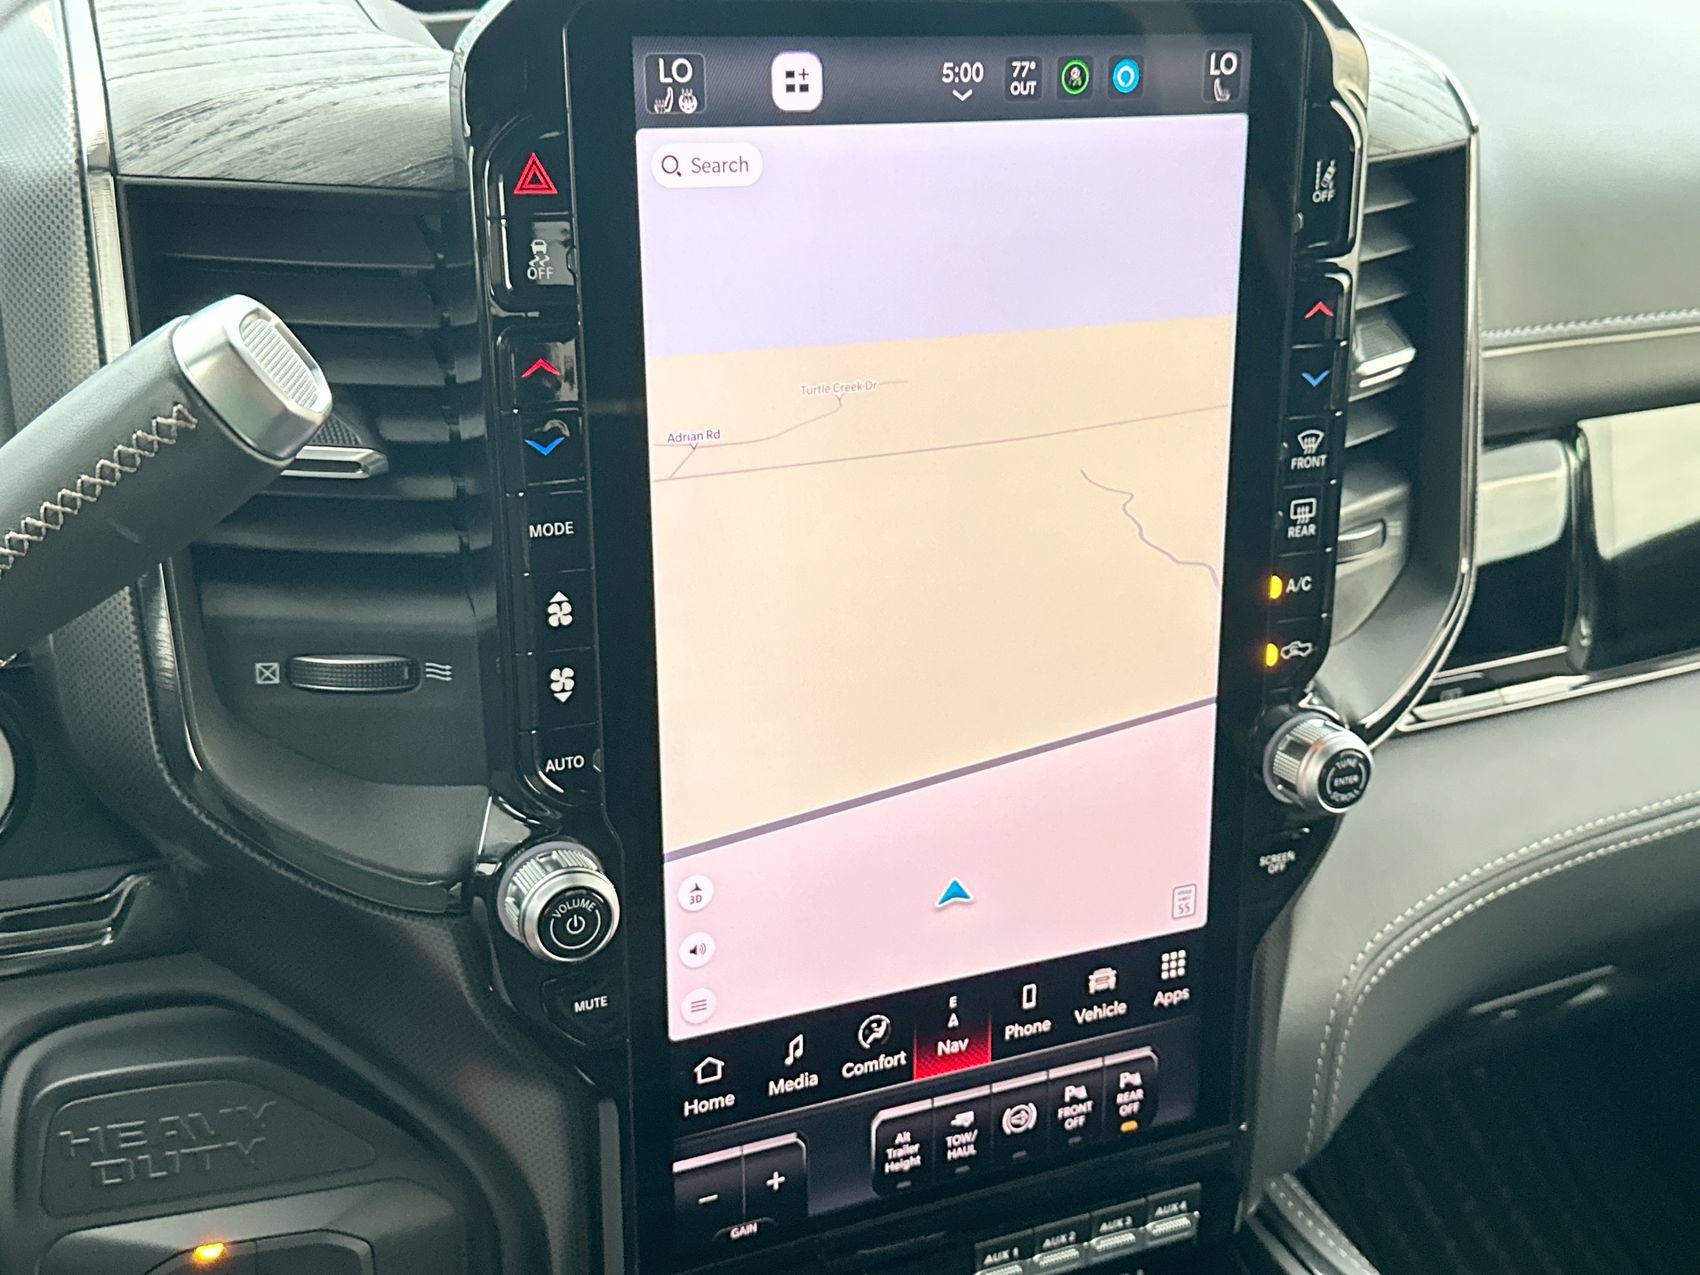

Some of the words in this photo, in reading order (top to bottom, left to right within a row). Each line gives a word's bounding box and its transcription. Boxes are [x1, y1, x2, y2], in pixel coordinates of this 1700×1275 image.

[659, 57, 693, 83] LO
[941, 61, 984, 83] 5:00
[1210, 51, 1238, 76] LO
[1010, 81, 1037, 95] OUT
[690, 155, 750, 176] Search
[1312, 189, 1336, 203] OFF
[527, 267, 553, 280] OFF
[801, 384, 830, 396] Turtle
[832, 381, 863, 394] Creek
[864, 380, 878, 391] Dr
[667, 432, 704, 444] Adrian
[706, 430, 721, 441] Rd
[1291, 455, 1328, 470] FRONT
[529, 521, 575, 538] MODE
[1288, 525, 1317, 538] REAR
[1286, 576, 1313, 594] A/C
[545, 755, 585, 773] AUTO
[1336, 758, 1358, 769] TUNE
[1333, 774, 1360, 787] ENTER
[1259, 850, 1296, 867] SCREEN
[1267, 862, 1287, 875] OFF
[690, 894, 703, 904] 3D
[1178, 902, 1191, 914] 55
[552, 898, 597, 920] VOLUME
[574, 995, 609, 1014] MUTE
[1153, 986, 1191, 1008] Apps
[1073, 1000, 1127, 1025] Vehicle
[1004, 1018, 1052, 1041] Phone
[937, 1037, 969, 1056] Nav
[841, 1050, 907, 1079] Comfort
[767, 1070, 819, 1097] Media
[683, 1092, 736, 1118] Home
[1116, 1088, 1145, 1105] REAR
[1057, 1100, 1094, 1120] FRONT
[1119, 1101, 1140, 1117] OFF
[58, 1100, 278, 1157] HEAVY
[1064, 1114, 1086, 1131] OFF
[945, 1129, 979, 1147] TOW/
[89, 1135, 266, 1185] DUTY
[886, 1143, 920, 1159] Trailer
[946, 1144, 977, 1160] HAUL
[884, 1155, 921, 1175] Height
[1155, 1204, 1181, 1217] AUX
[730, 1222, 758, 1240] GAIN
[1100, 1219, 1124, 1233] AUX
[1125, 1216, 1133, 1227] 3
[1043, 1235, 1068, 1249] AUX
[1068, 1231, 1077, 1243] 2
[983, 1251, 1009, 1265] AUX
[1012, 1247, 1019, 1258] 1
